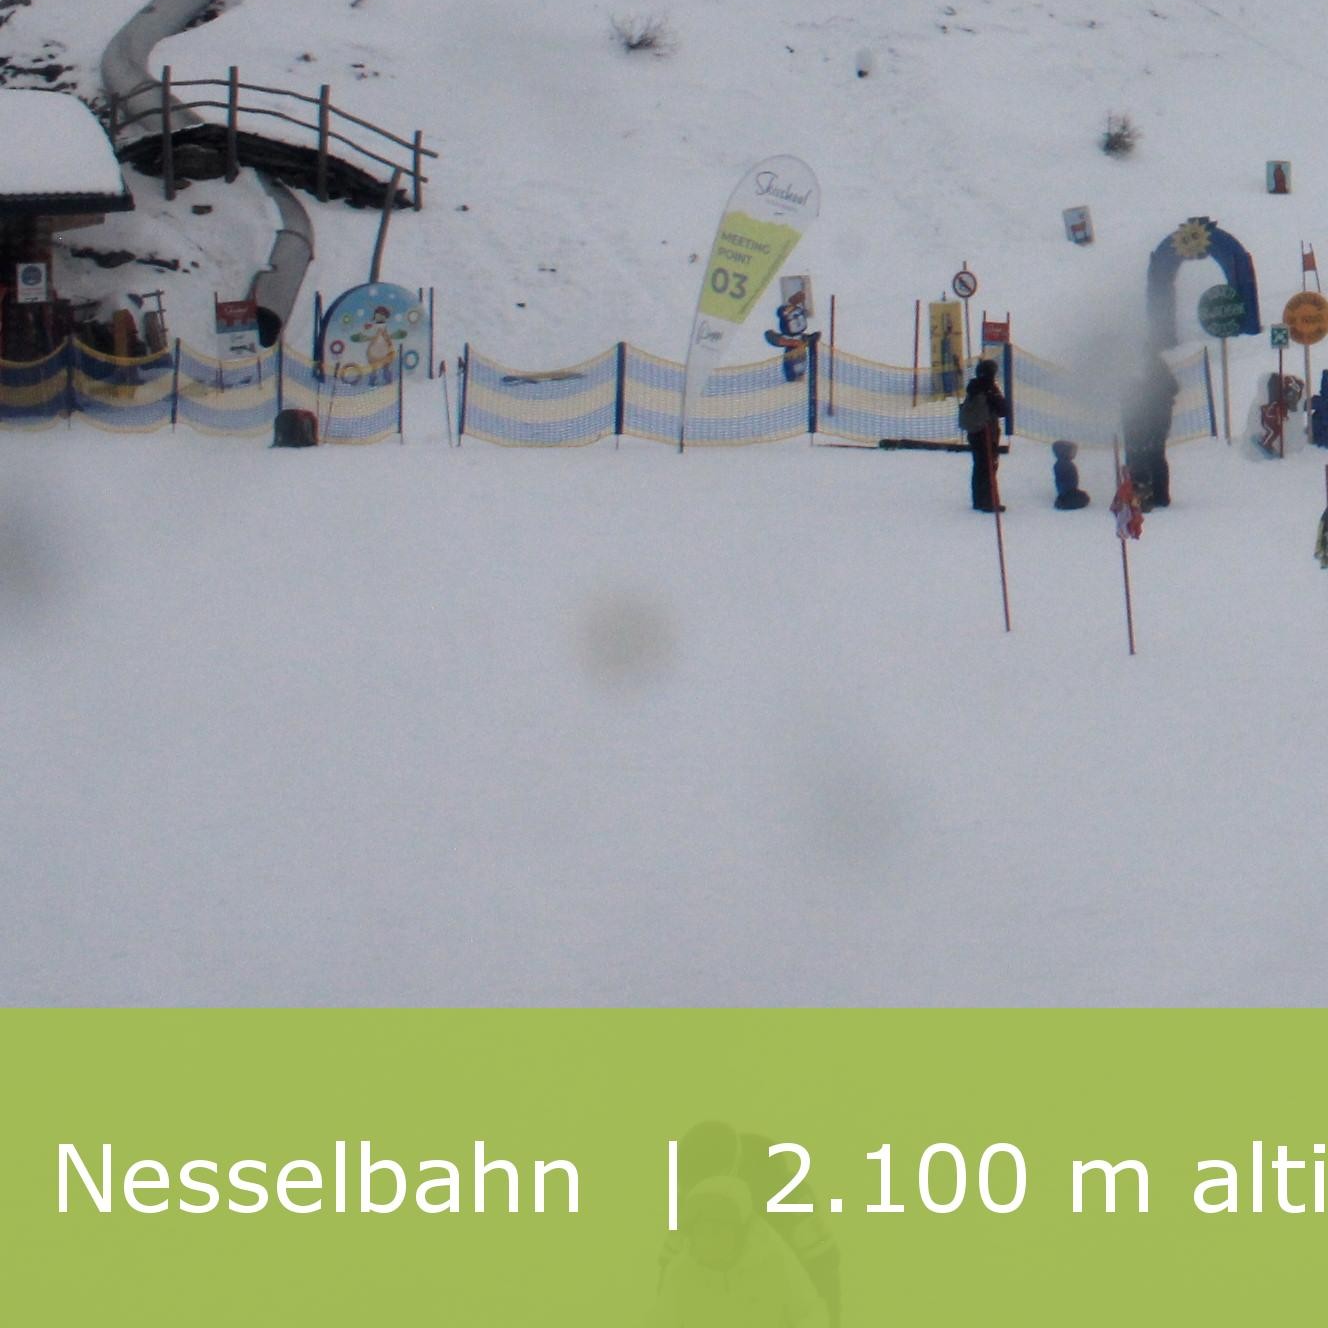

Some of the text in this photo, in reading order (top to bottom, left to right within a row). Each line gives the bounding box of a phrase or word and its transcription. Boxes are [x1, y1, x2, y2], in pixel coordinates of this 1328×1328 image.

[721, 231, 770, 254] MEETING
[718, 247, 752, 264] POINT
[711, 267, 748, 299] 03
